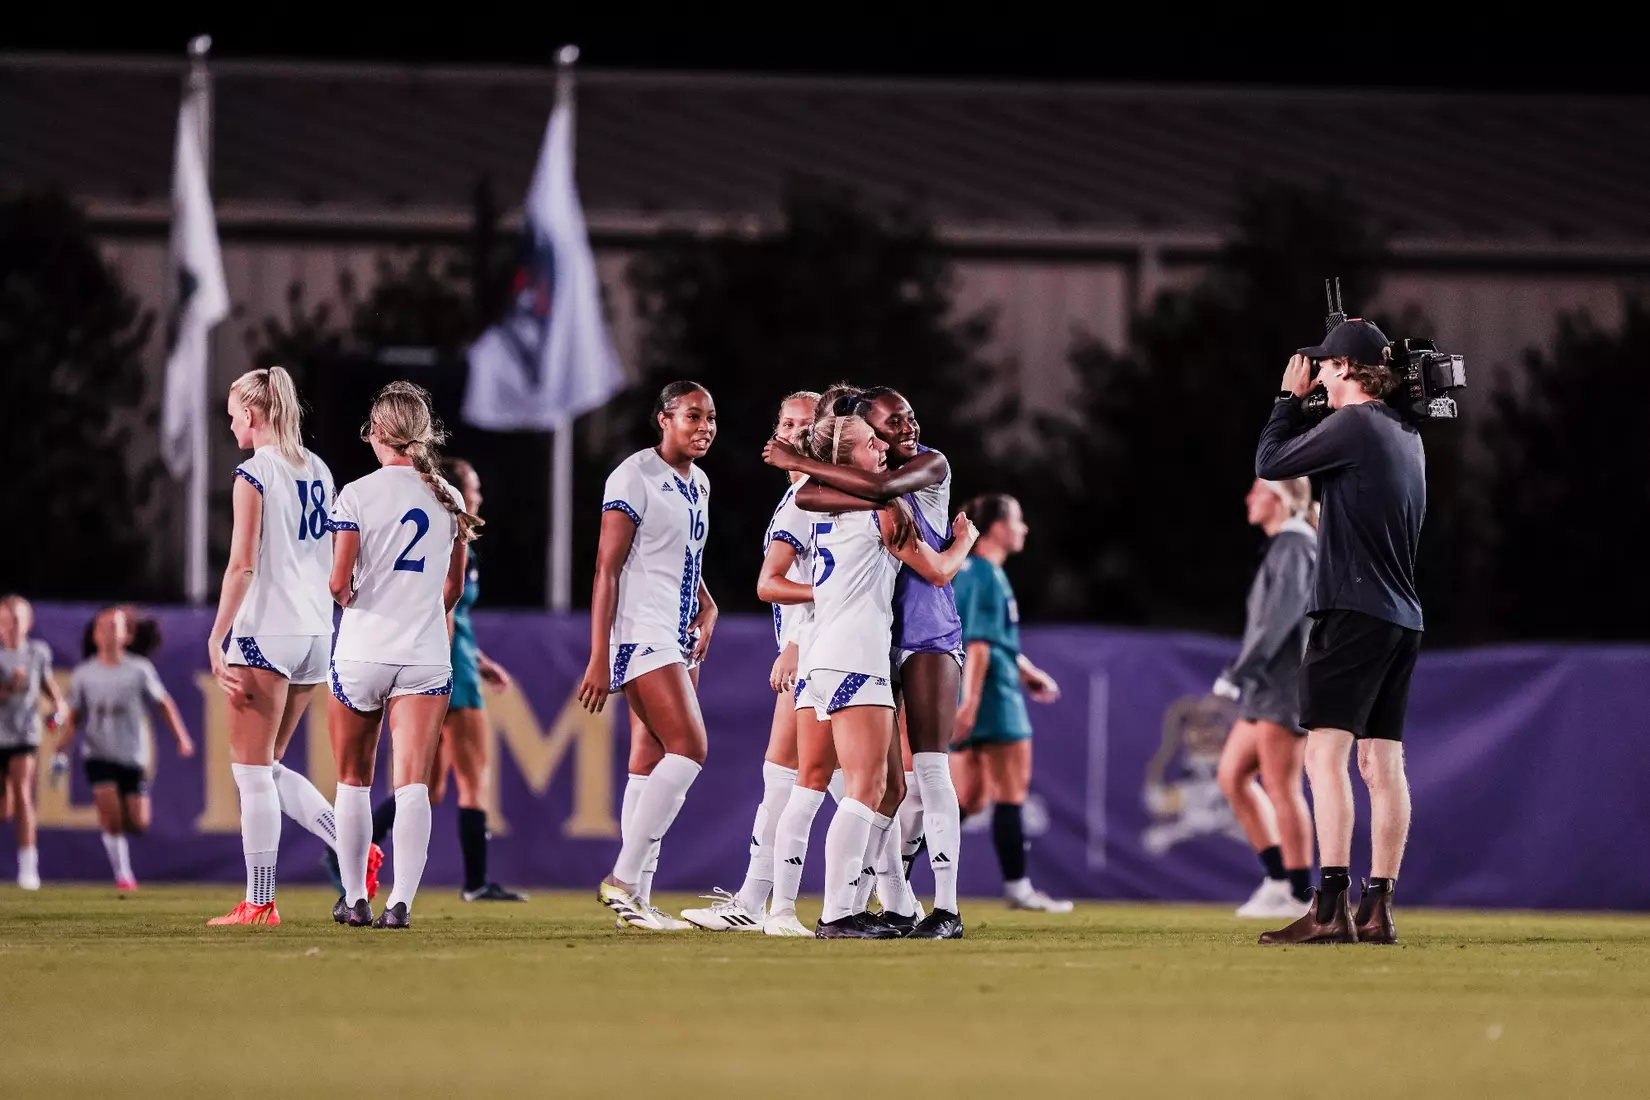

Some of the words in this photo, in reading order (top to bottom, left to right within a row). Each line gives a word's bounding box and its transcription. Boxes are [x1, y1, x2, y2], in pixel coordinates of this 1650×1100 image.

[296, 480, 328, 540] 18
[688, 508, 705, 541] 16
[393, 508, 430, 573] 2
